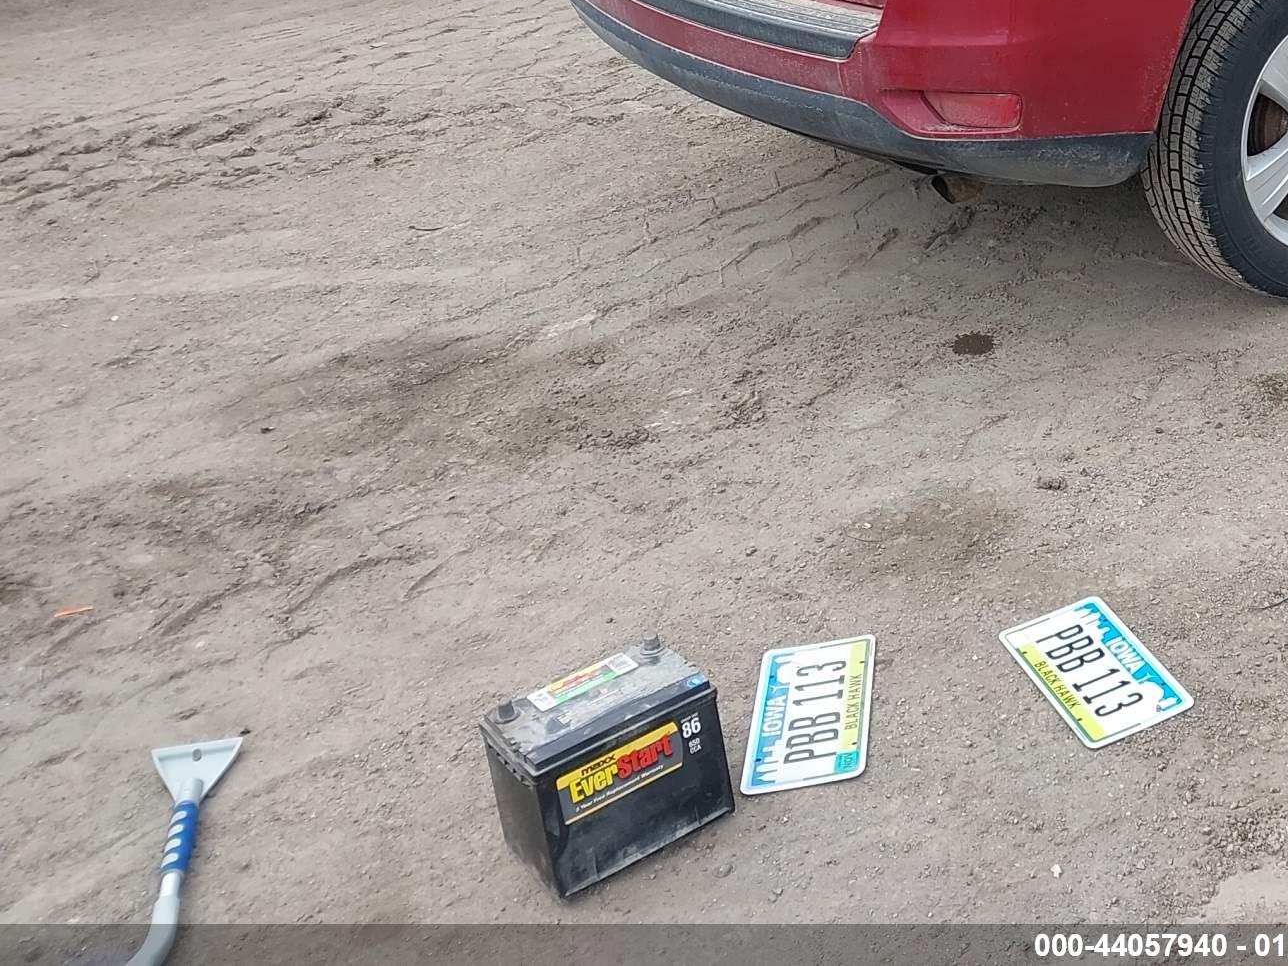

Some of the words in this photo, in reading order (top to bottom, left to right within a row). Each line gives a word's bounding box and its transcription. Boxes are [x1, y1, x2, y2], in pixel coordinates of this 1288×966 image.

[1035, 623, 1106, 673] PBB
[1072, 667, 1144, 717] 113
[1103, 634, 1146, 674] IOWA
[792, 660, 847, 707] 113
[847, 673, 863, 700] HAWK
[1034, 660, 1061, 686] BLACK
[1054, 683, 1081, 710] HAWK
[681, 716, 702, 739] 86
[761, 694, 788, 737] IOWA
[844, 700, 859, 731] BLACK
[784, 711, 841, 765] PBB
